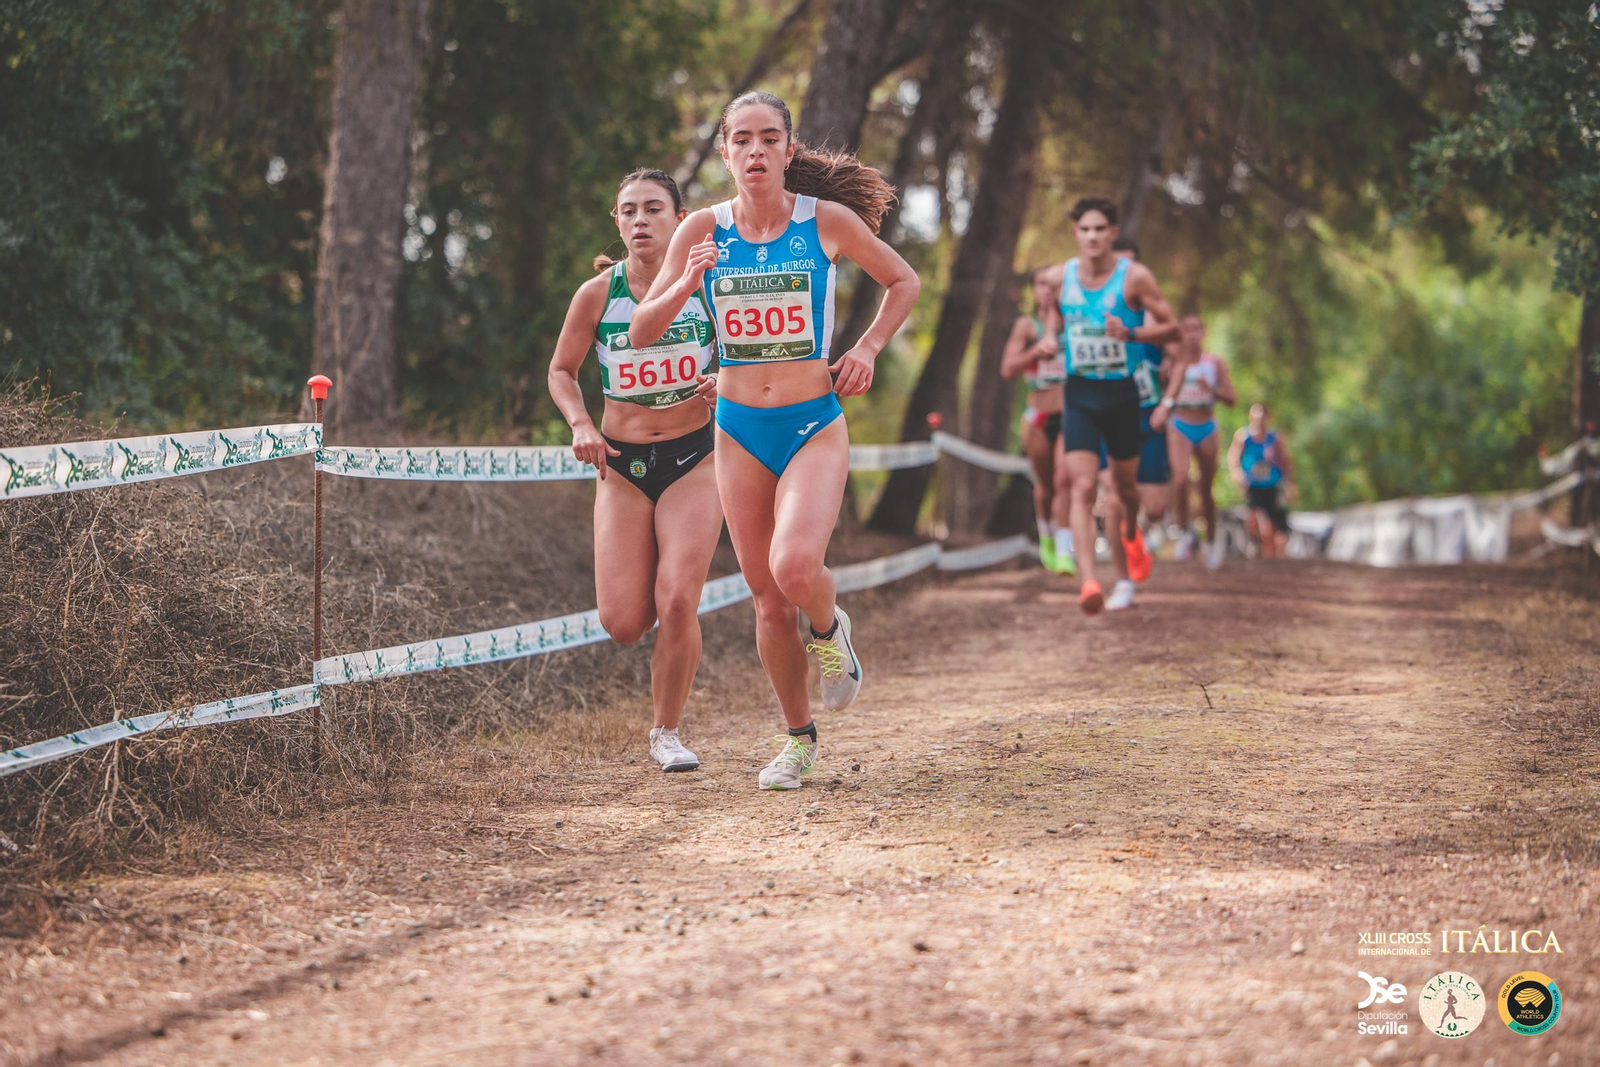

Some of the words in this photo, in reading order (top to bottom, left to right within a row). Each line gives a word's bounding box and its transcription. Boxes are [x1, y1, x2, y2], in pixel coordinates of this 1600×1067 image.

[711, 266, 765, 279] UNIVERSIDAD
[767, 264, 780, 273] DE
[781, 259, 815, 271] BURGOS
[739, 276, 785, 289] ITÁLICA
[682, 311, 700, 319] SCP
[725, 305, 806, 338] 6305
[618, 355, 697, 390] 5610
